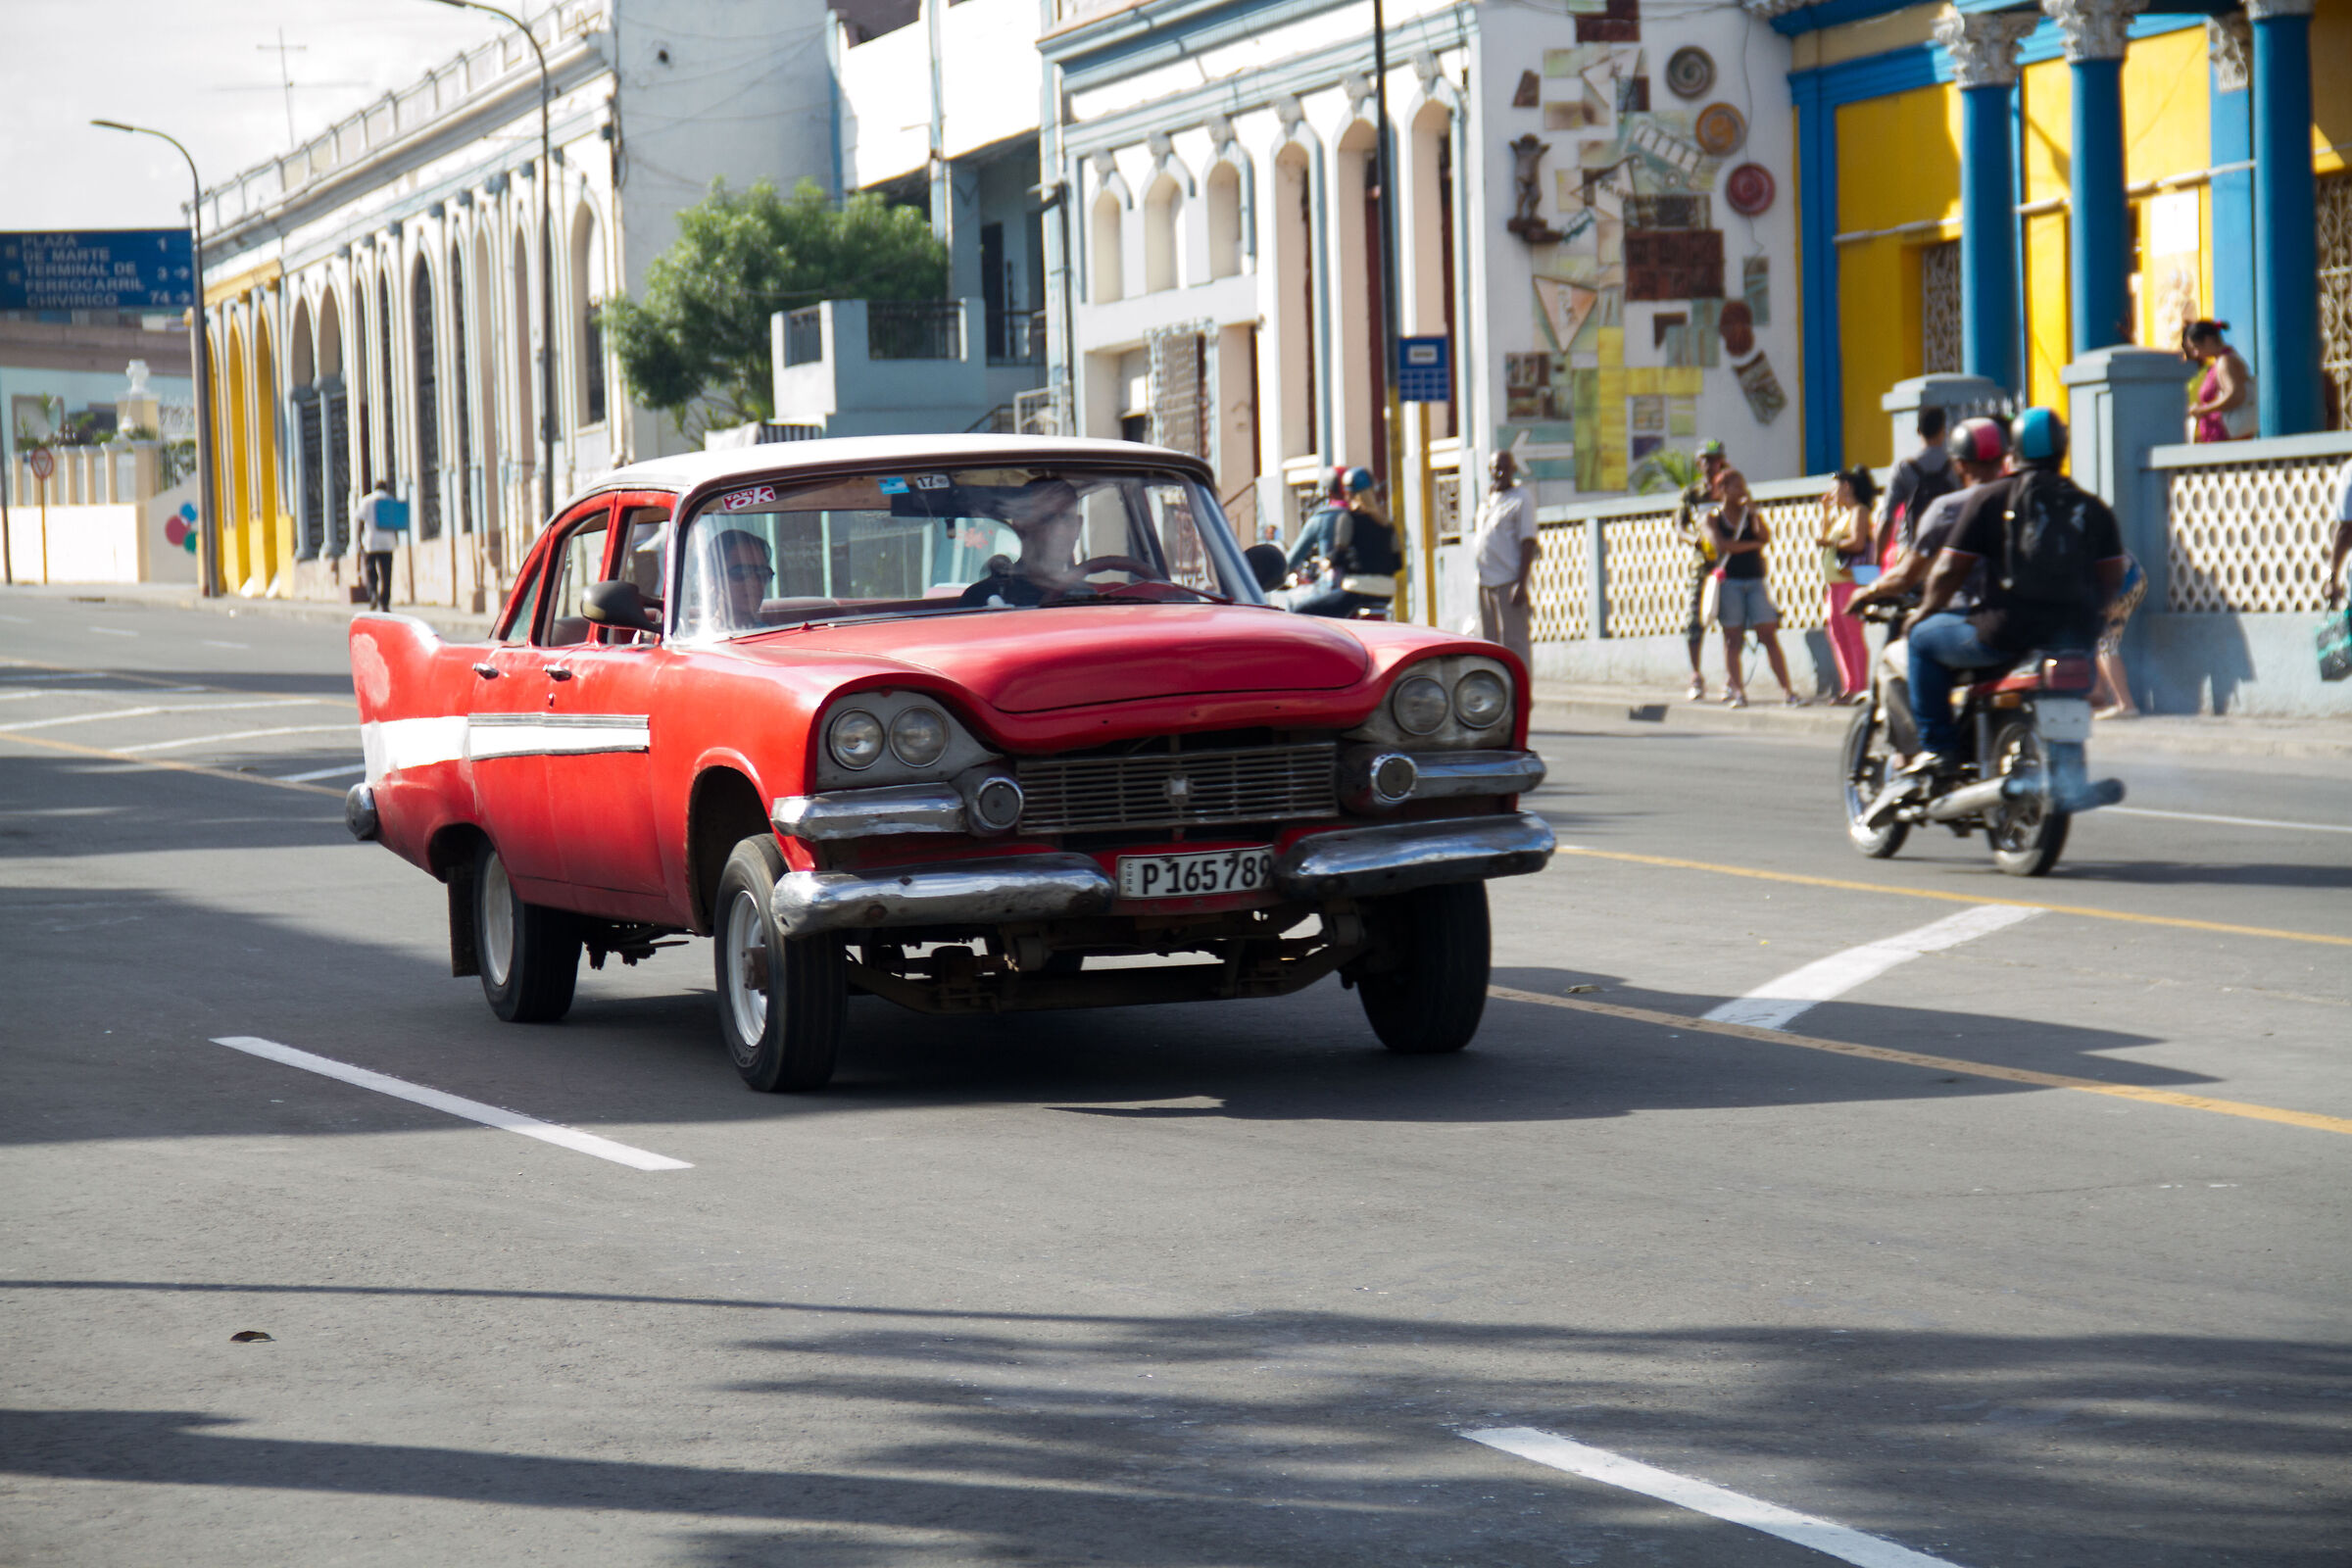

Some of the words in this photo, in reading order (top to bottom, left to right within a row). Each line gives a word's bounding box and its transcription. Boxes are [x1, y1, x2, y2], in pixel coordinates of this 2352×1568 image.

[22, 234, 77, 248] PLAZA
[158, 237, 167, 252] 1
[23, 249, 44, 264] DE
[52, 247, 110, 263] MARTE
[25, 264, 109, 276] TERMINAL
[114, 262, 136, 276] DE
[24, 277, 144, 292] FERROCARRIL
[26, 293, 118, 308] CHIVIRICO
[149, 289, 170, 306] 74
[917, 475, 933, 487] 17
[724, 490, 754, 501] TAXI
